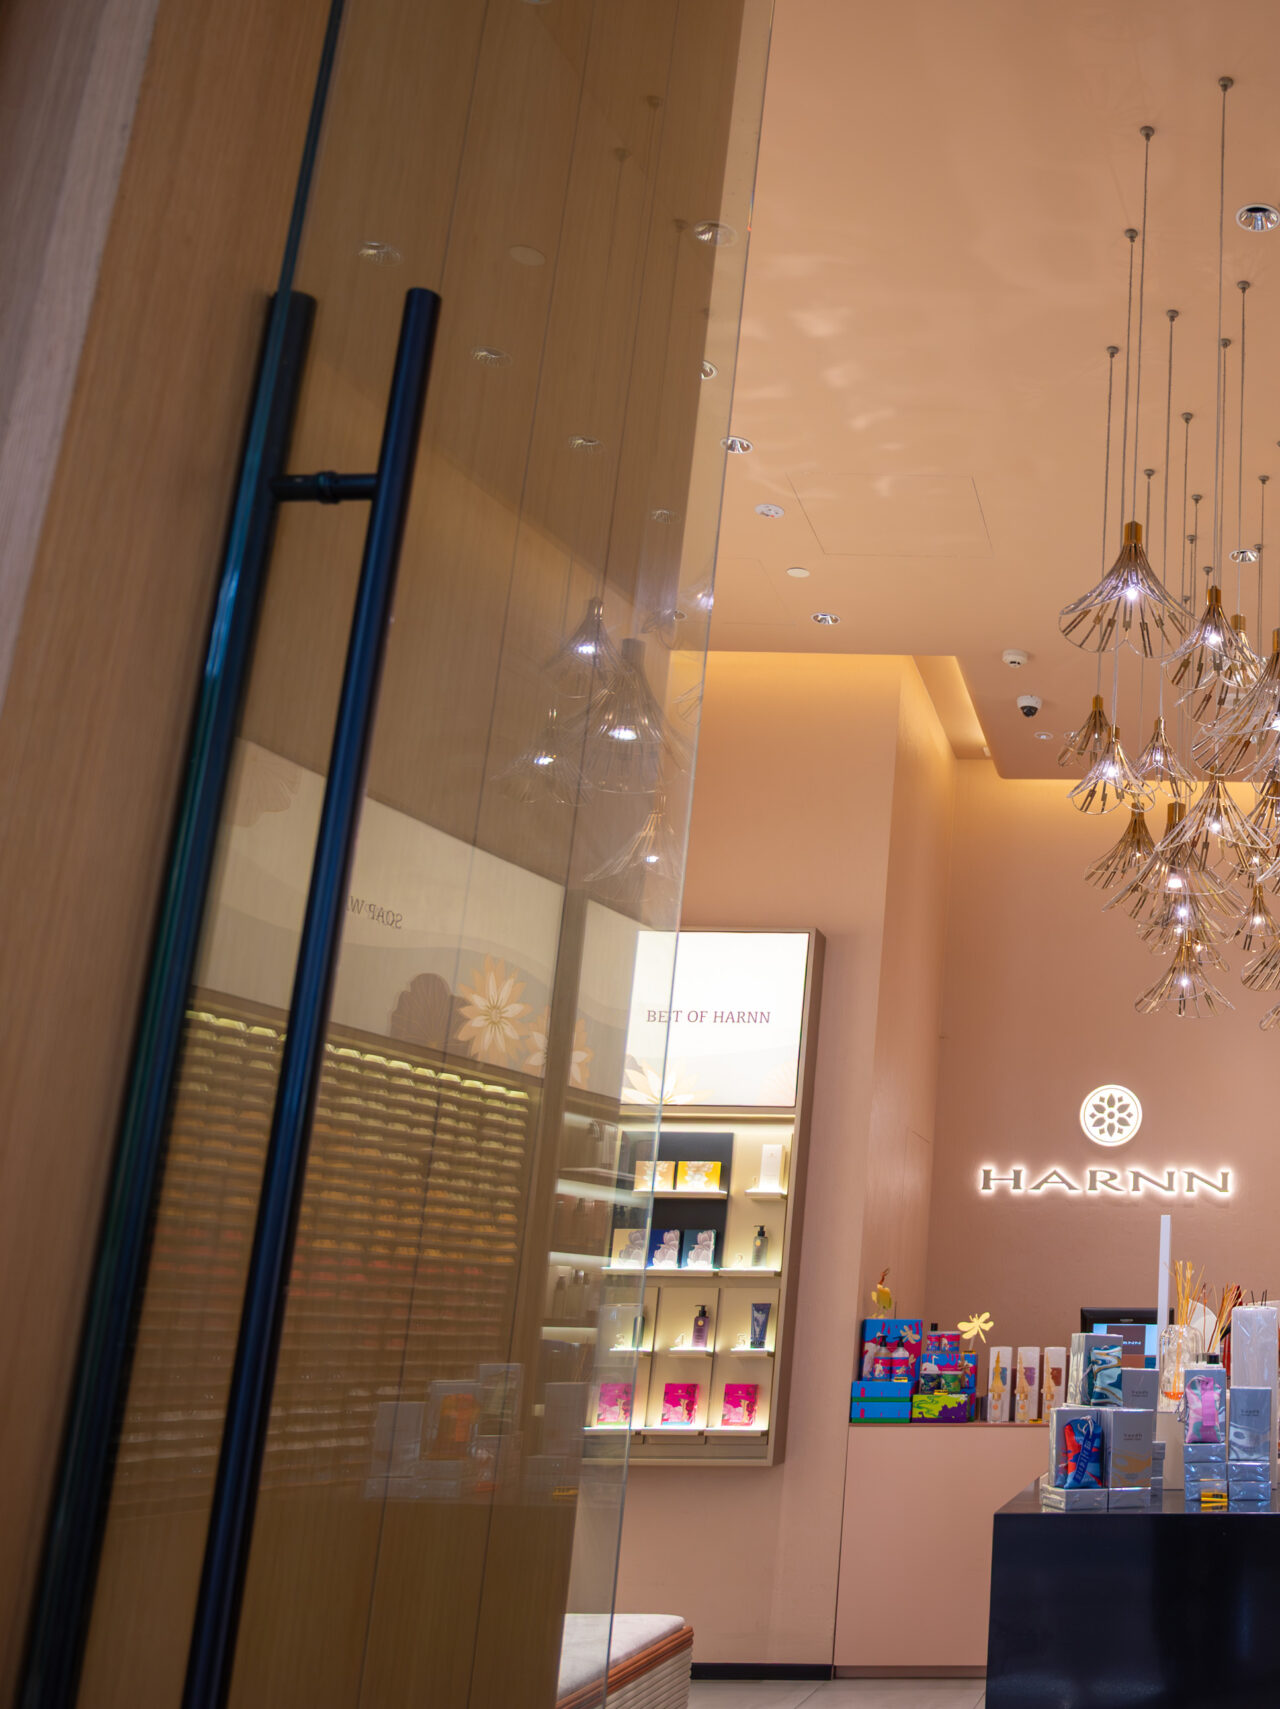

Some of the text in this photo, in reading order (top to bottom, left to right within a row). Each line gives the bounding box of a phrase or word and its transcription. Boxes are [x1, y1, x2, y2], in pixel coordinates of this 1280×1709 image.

[646, 1009, 771, 1024] BET OF HARNN
[980, 1168, 1230, 1193] HARNN
